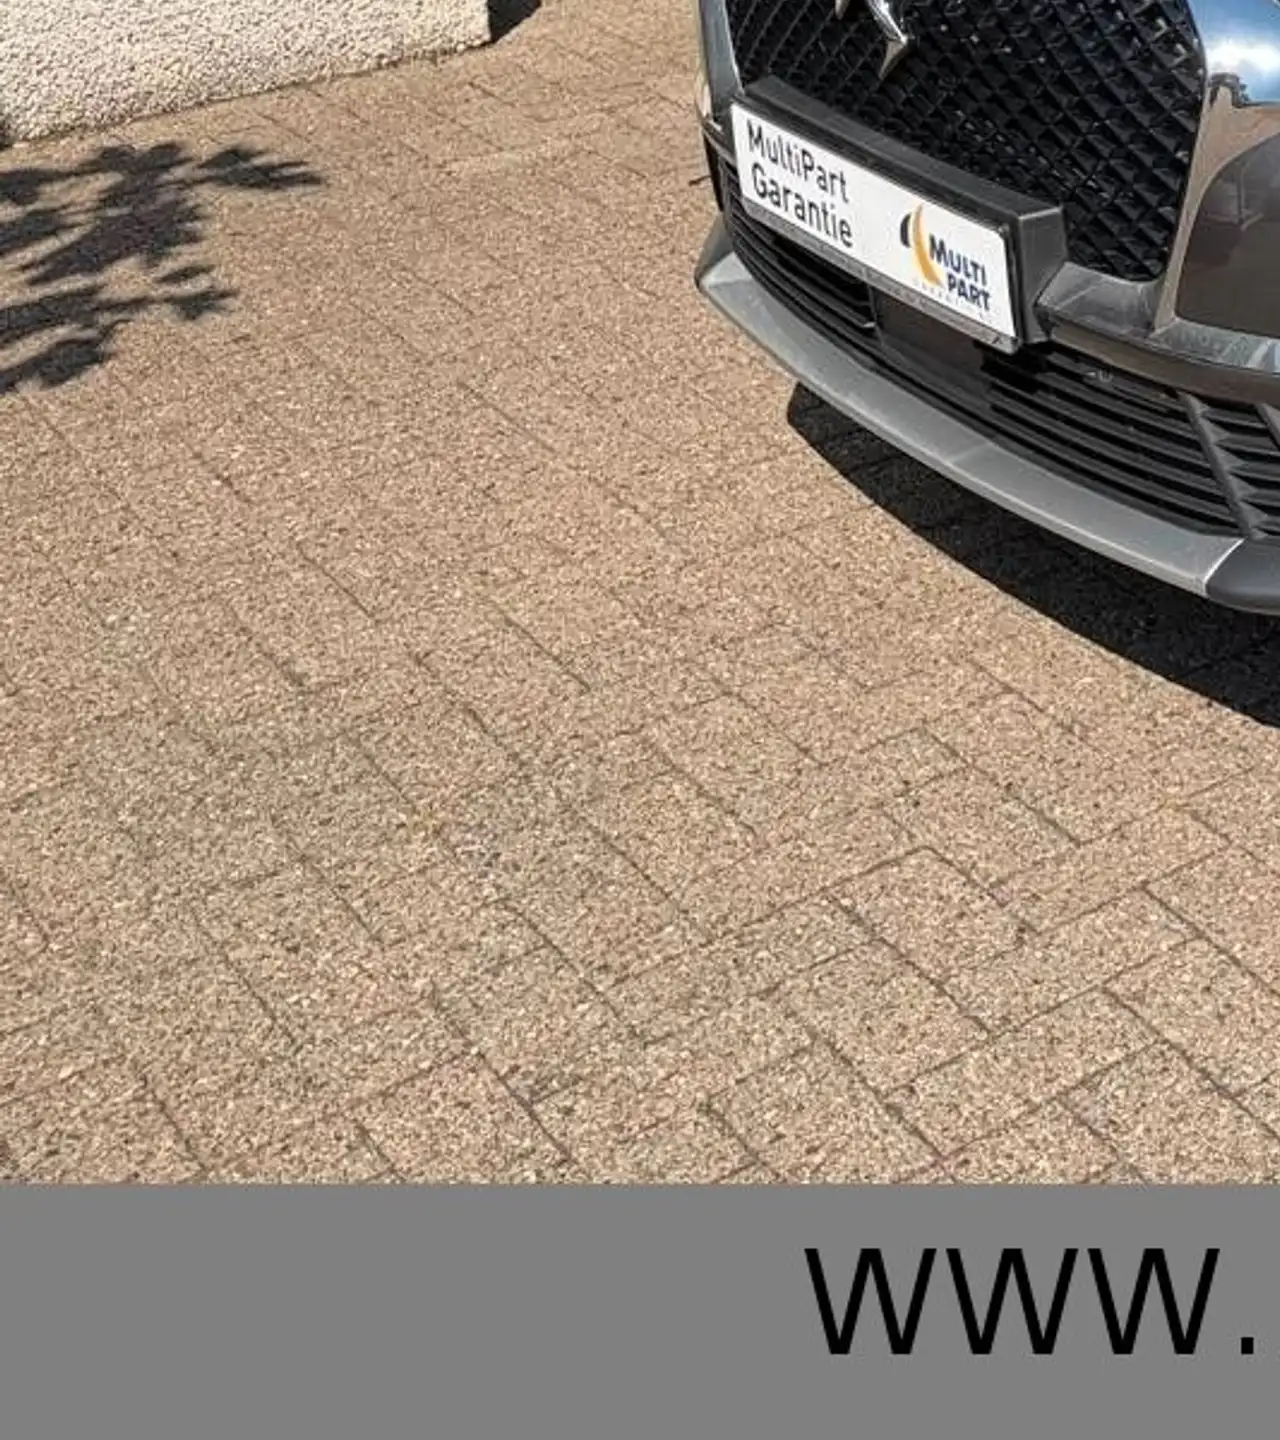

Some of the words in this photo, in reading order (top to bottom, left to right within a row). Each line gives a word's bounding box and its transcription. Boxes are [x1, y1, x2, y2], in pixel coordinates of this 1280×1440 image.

[746, 120, 850, 203] MultiPart
[751, 162, 853, 248] Garantie
[928, 233, 988, 287] MULTI
[946, 273, 991, 311] PART
